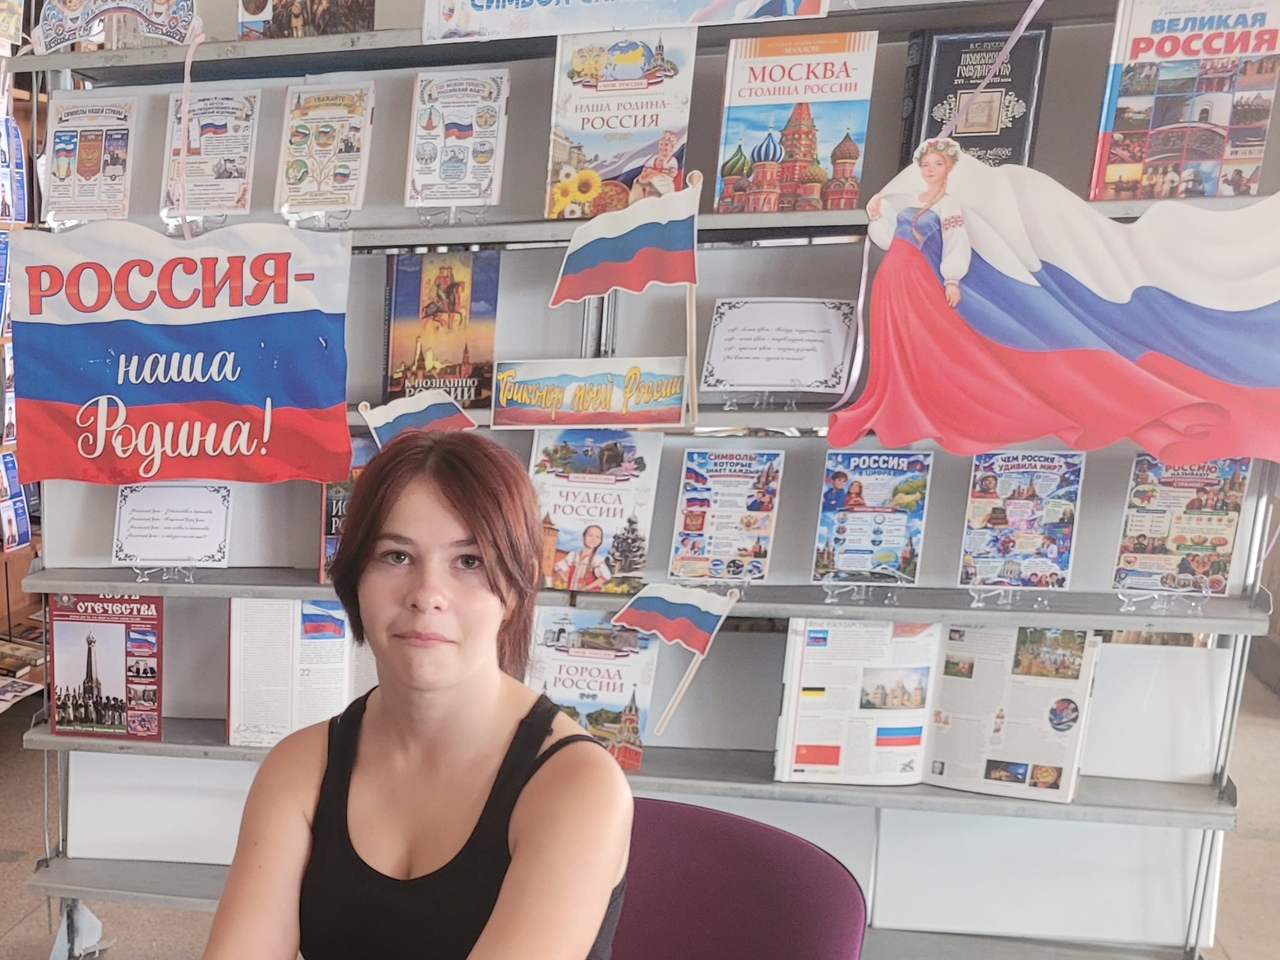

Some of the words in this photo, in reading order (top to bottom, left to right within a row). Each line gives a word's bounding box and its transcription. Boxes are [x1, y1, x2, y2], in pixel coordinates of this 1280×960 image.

[1150, 12, 1267, 35] ВЕЛИКАЯ
[1129, 29, 1280, 60] РОССИЯ
[747, 60, 858, 84] МОСКВА-
[738, 85, 799, 98] СТОЛИЦА
[803, 82, 858, 94] РОССИИ
[104, 107, 124, 117] СТРАНЫ
[574, 102, 611, 113] НАША
[581, 113, 660, 130] РОССИЯ
[25, 252, 315, 315] РОССИЯ-
[118, 350, 241, 385] наша
[405, 379, 412, 388] К
[415, 377, 478, 388] ПОЗНАНИЮ
[497, 368, 564, 420] Триколор
[570, 374, 614, 411] моей
[621, 366, 684, 415] России
[75, 394, 272, 478] Родина!
[713, 461, 753, 469] КОТОРЫЕ
[850, 457, 908, 471] РОССИЯ
[1001, 455, 1020, 463] ЧЕМ
[1021, 454, 1056, 463] РОССИЯ
[998, 463, 1037, 472] УДИВИЛА
[1039, 463, 1063, 474] МИР?
[1164, 463, 1217, 474] РОССИЮ
[558, 490, 623, 505] ЧУДЕСА
[553, 505, 624, 519] РОССИИ
[77, 602, 157, 616] ОТЕЧЕСТВА
[558, 664, 623, 680] ГОРОДА
[553, 677, 624, 693] РОССИИ
